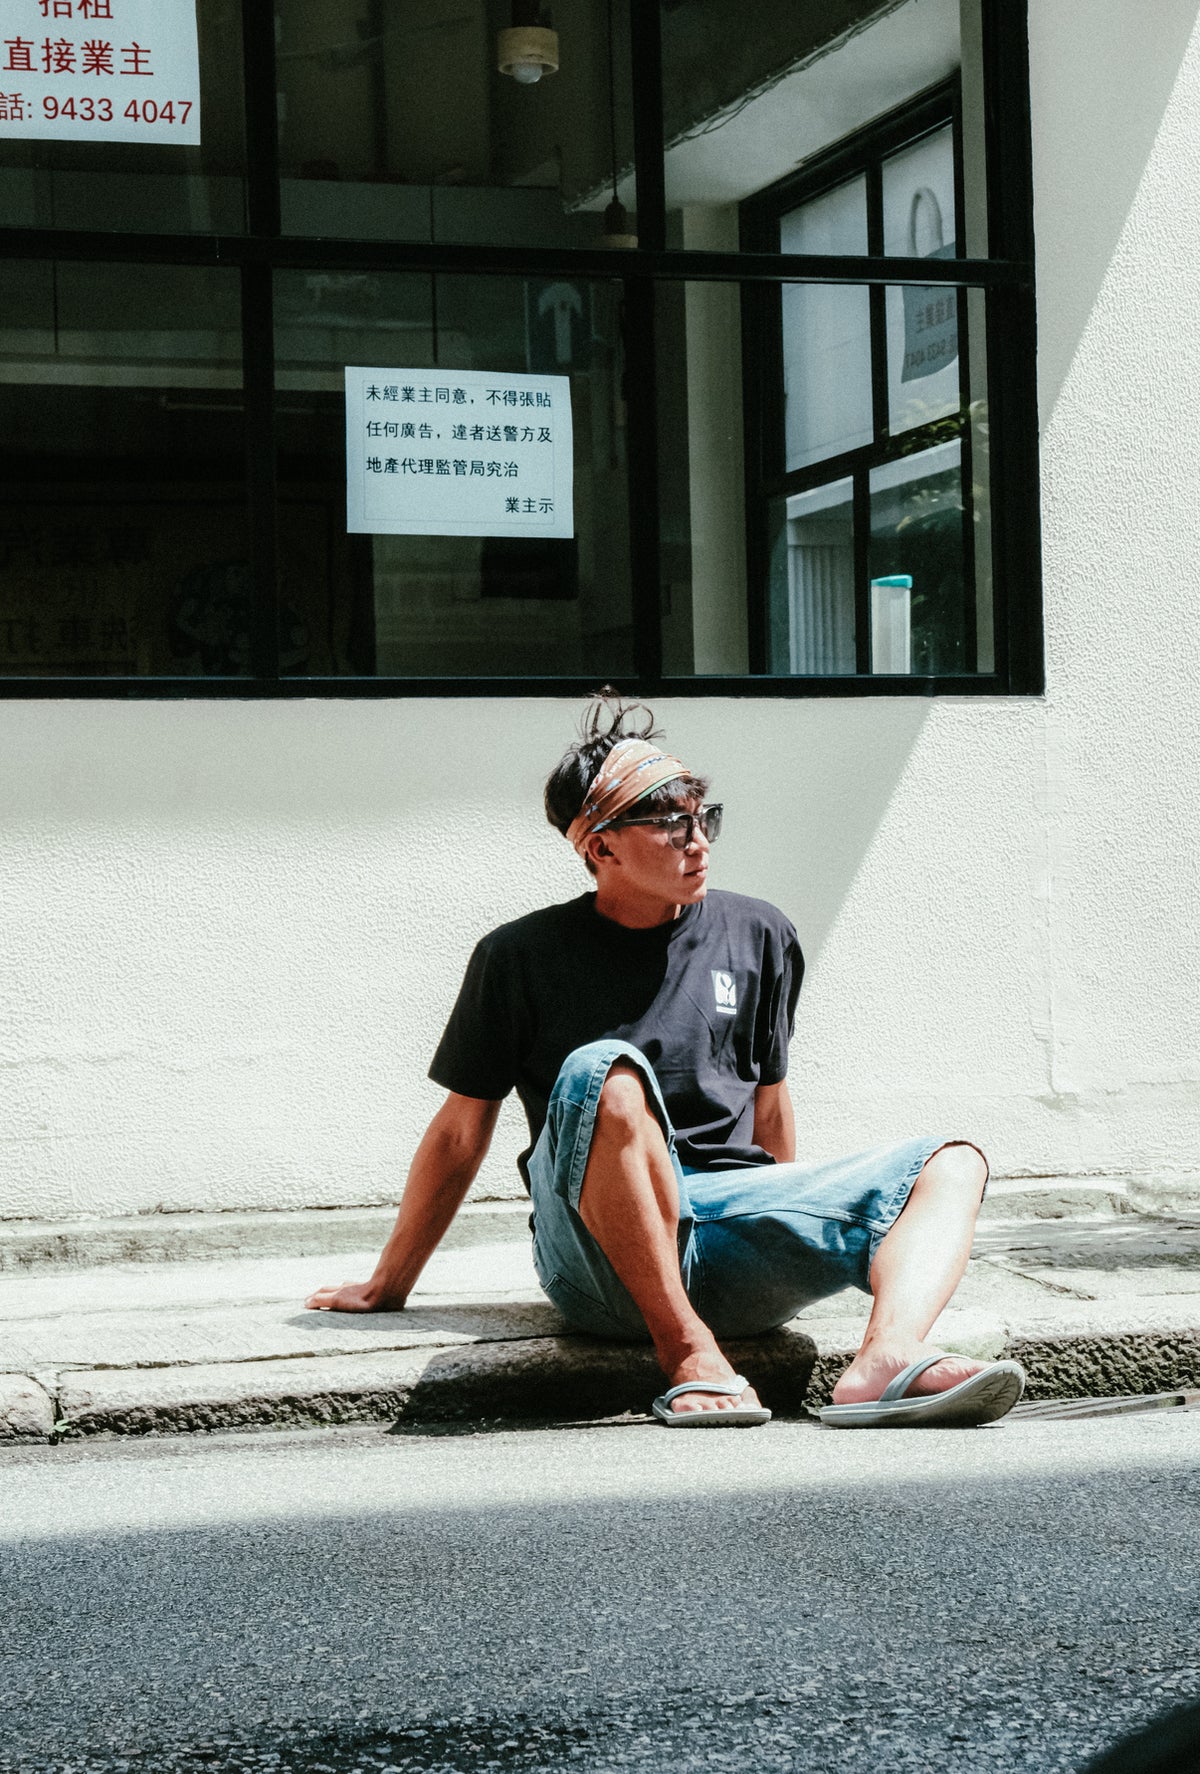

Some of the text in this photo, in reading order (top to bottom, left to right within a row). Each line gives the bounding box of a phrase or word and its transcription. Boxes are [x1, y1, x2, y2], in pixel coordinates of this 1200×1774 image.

[3, 36, 154, 76] 直接業主
[43, 96, 114, 122] 9433
[123, 99, 193, 125] 4047
[366, 457, 519, 477] 地產代理監管局究治
[505, 497, 554, 513] 業主示
